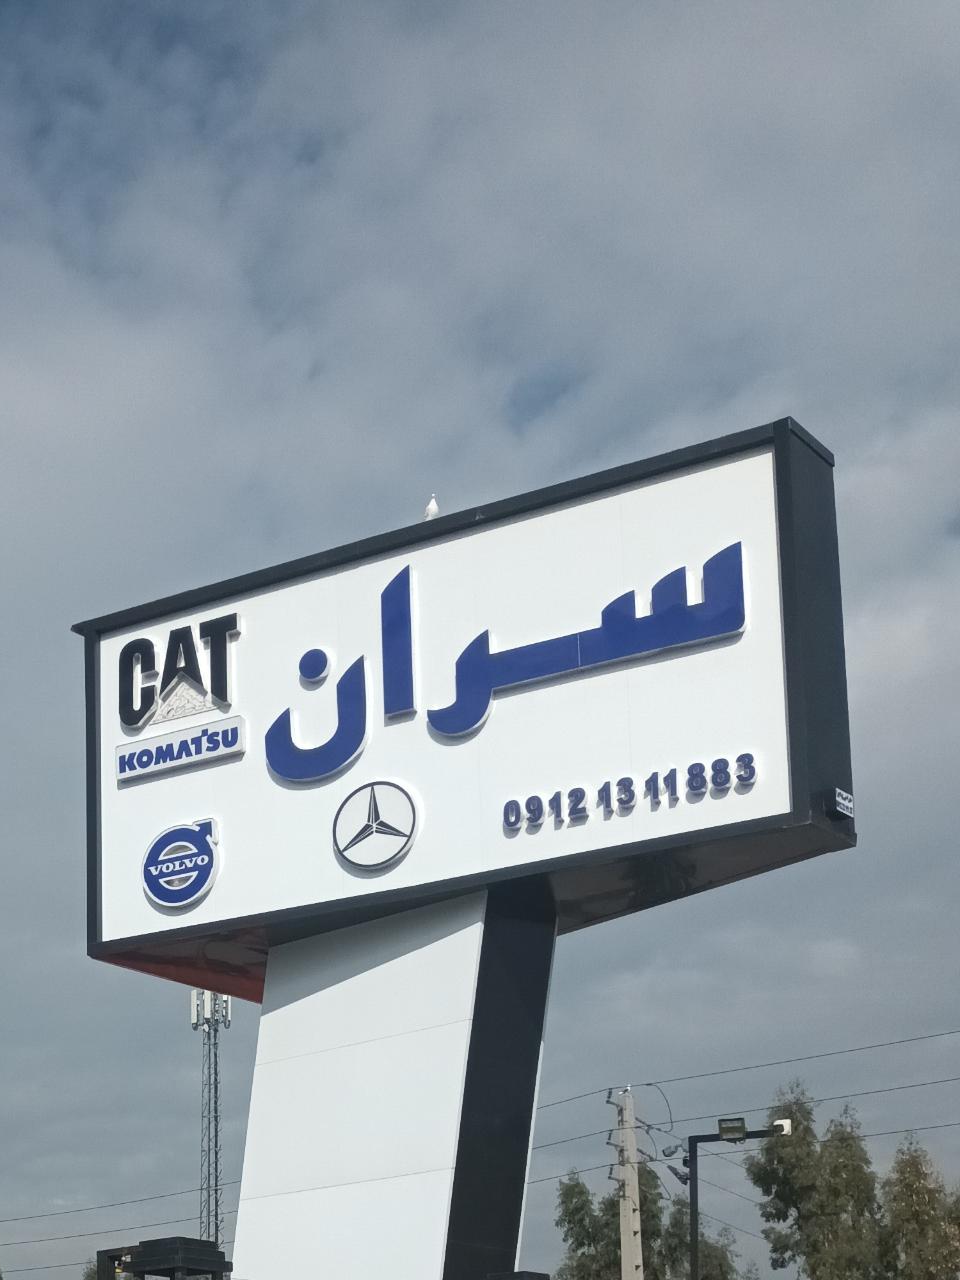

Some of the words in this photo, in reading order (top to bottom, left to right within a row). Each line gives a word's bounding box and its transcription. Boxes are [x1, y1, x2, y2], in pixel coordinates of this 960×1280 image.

[118, 612, 239, 727] CAT
[264, 541, 746, 781] سران
[118, 726, 239, 774] KOMATSU
[147, 854, 210, 877] VOLVO
